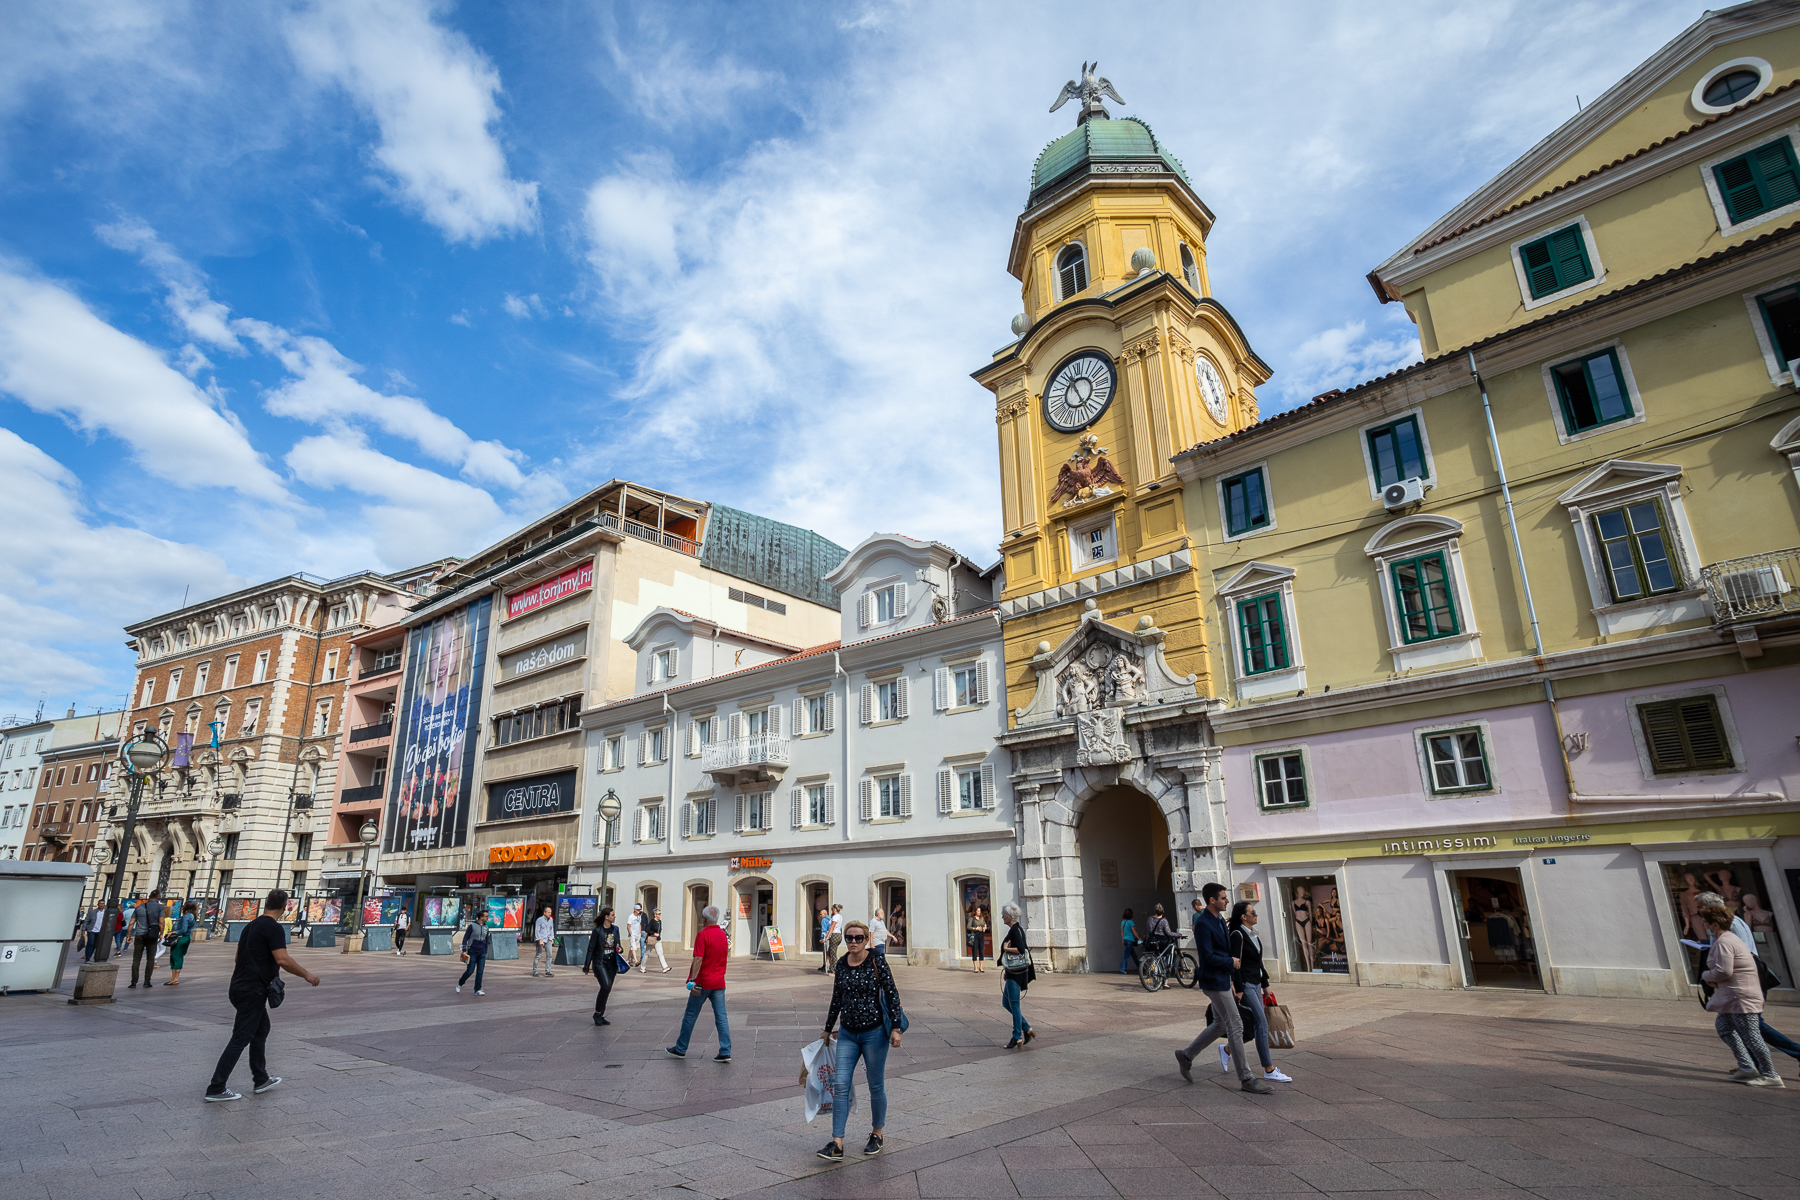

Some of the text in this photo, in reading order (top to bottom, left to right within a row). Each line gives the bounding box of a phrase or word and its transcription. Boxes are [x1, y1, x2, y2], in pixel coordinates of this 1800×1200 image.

[1092, 546, 1103, 559] 25
[504, 782, 560, 812] CENTRA
[1550, 833, 1591, 843] lingerie
[489, 843, 555, 863] KORZO
[740, 857, 772, 868] Müller
[466, 870, 490, 883] TOMMY
[5, 950, 13, 960] 8
